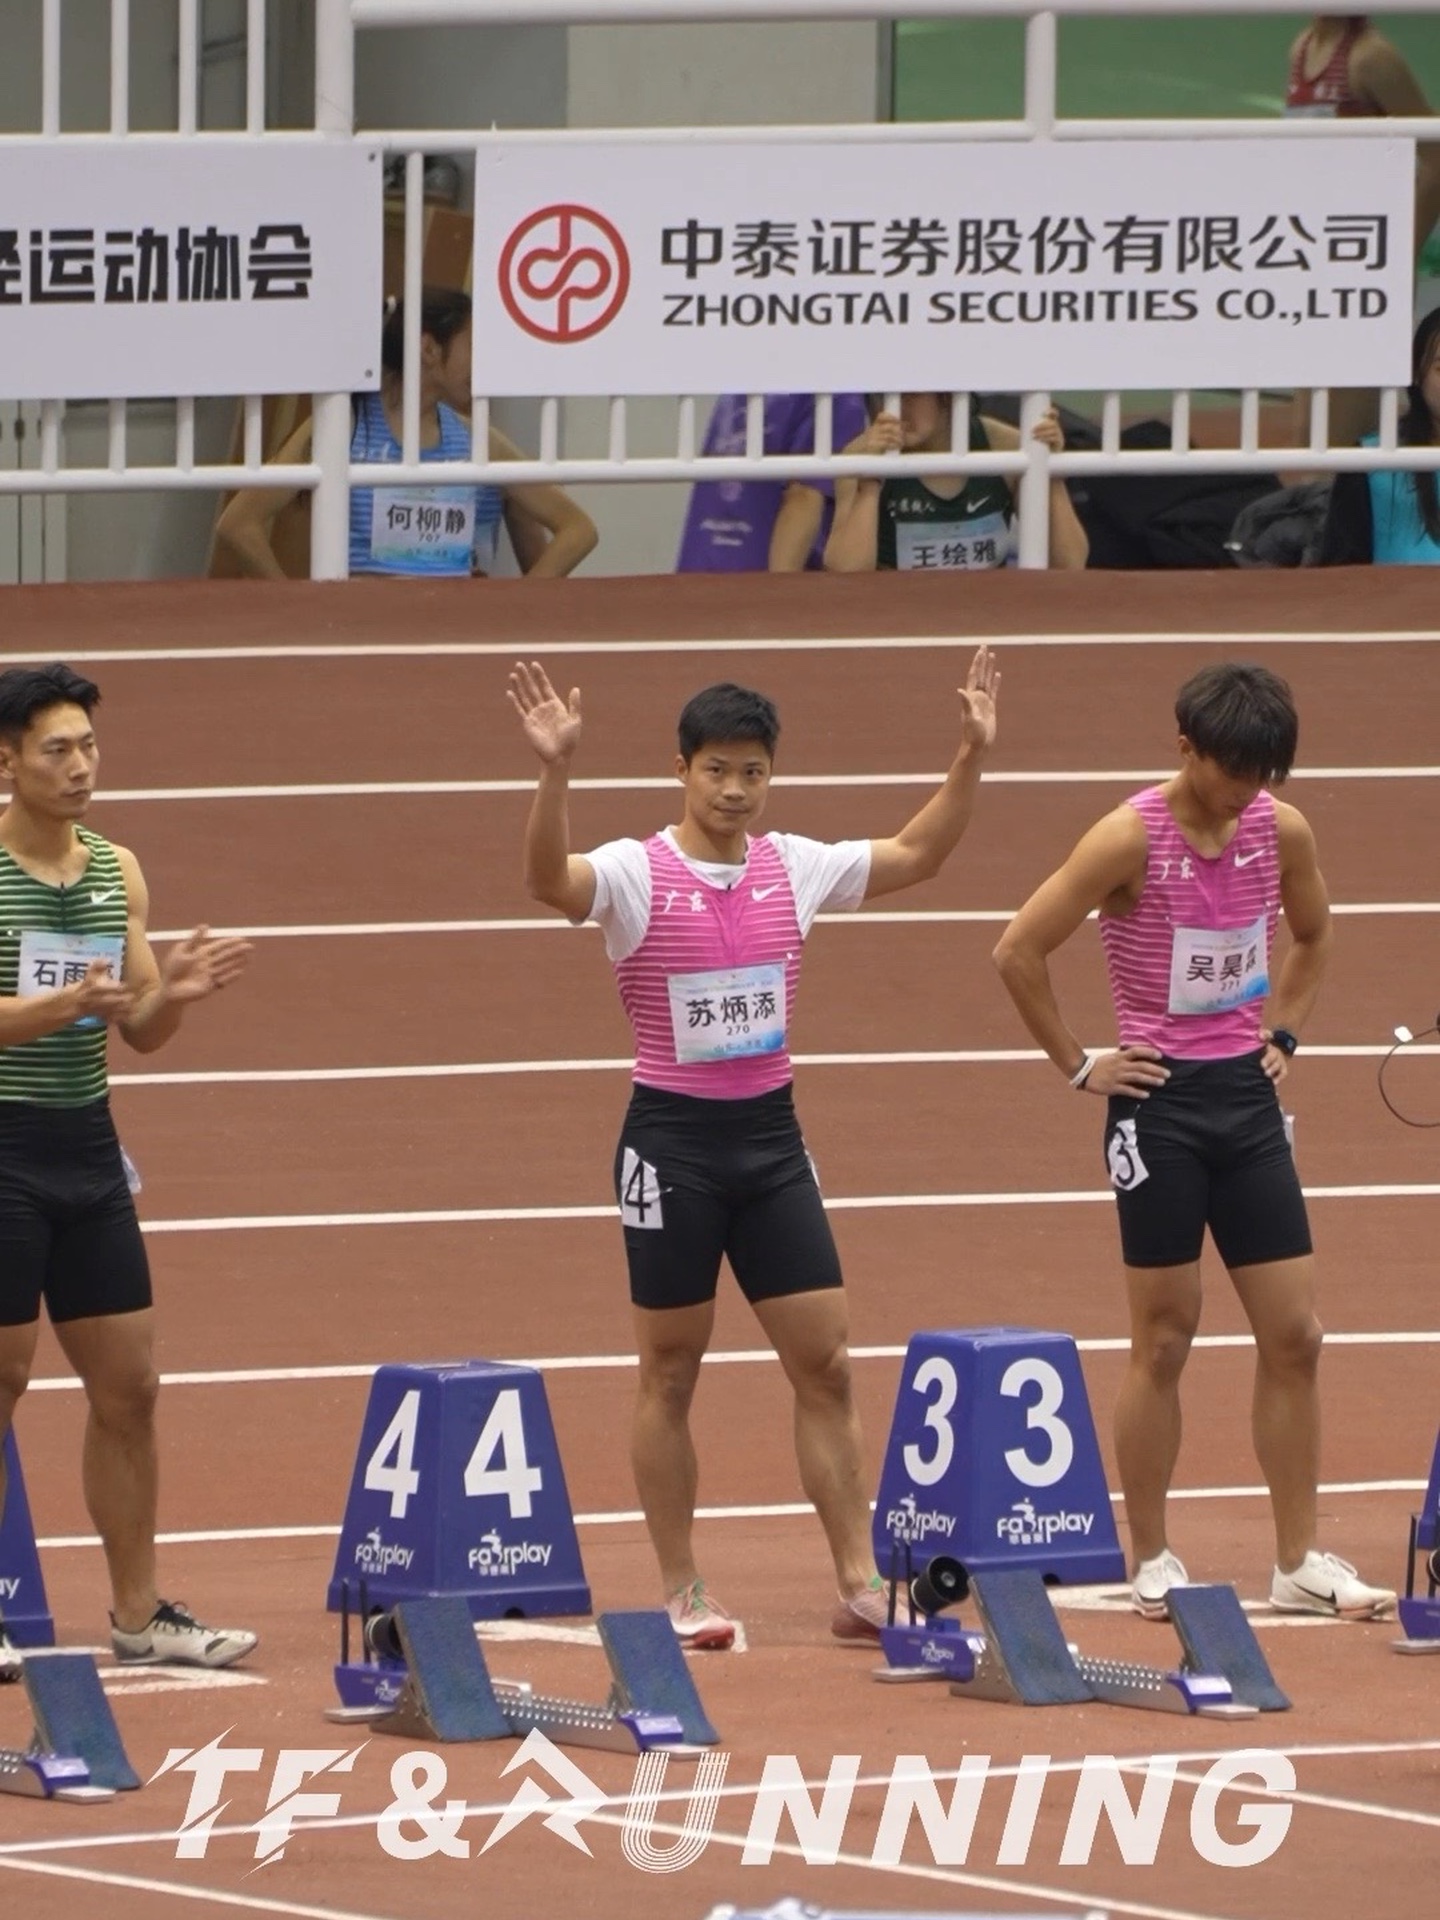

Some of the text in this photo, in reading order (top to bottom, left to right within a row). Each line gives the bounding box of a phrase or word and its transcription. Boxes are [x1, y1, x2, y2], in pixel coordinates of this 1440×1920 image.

[660, 214, 1388, 279] 中泰证券股份有限公司
[662, 287, 1388, 327] ZHONGTAI SECURITIES CO.,LTD
[386, 503, 467, 535] 何柳静
[33, 958, 116, 988] 石雨
[686, 990, 777, 1029] 苏炳添
[726, 1024, 751, 1037] 270
[624, 1158, 653, 1223] 4
[903, 1356, 958, 1486] 3
[1000, 1358, 1074, 1487] 3
[364, 1389, 421, 1519] 4
[464, 1389, 542, 1519] 4
